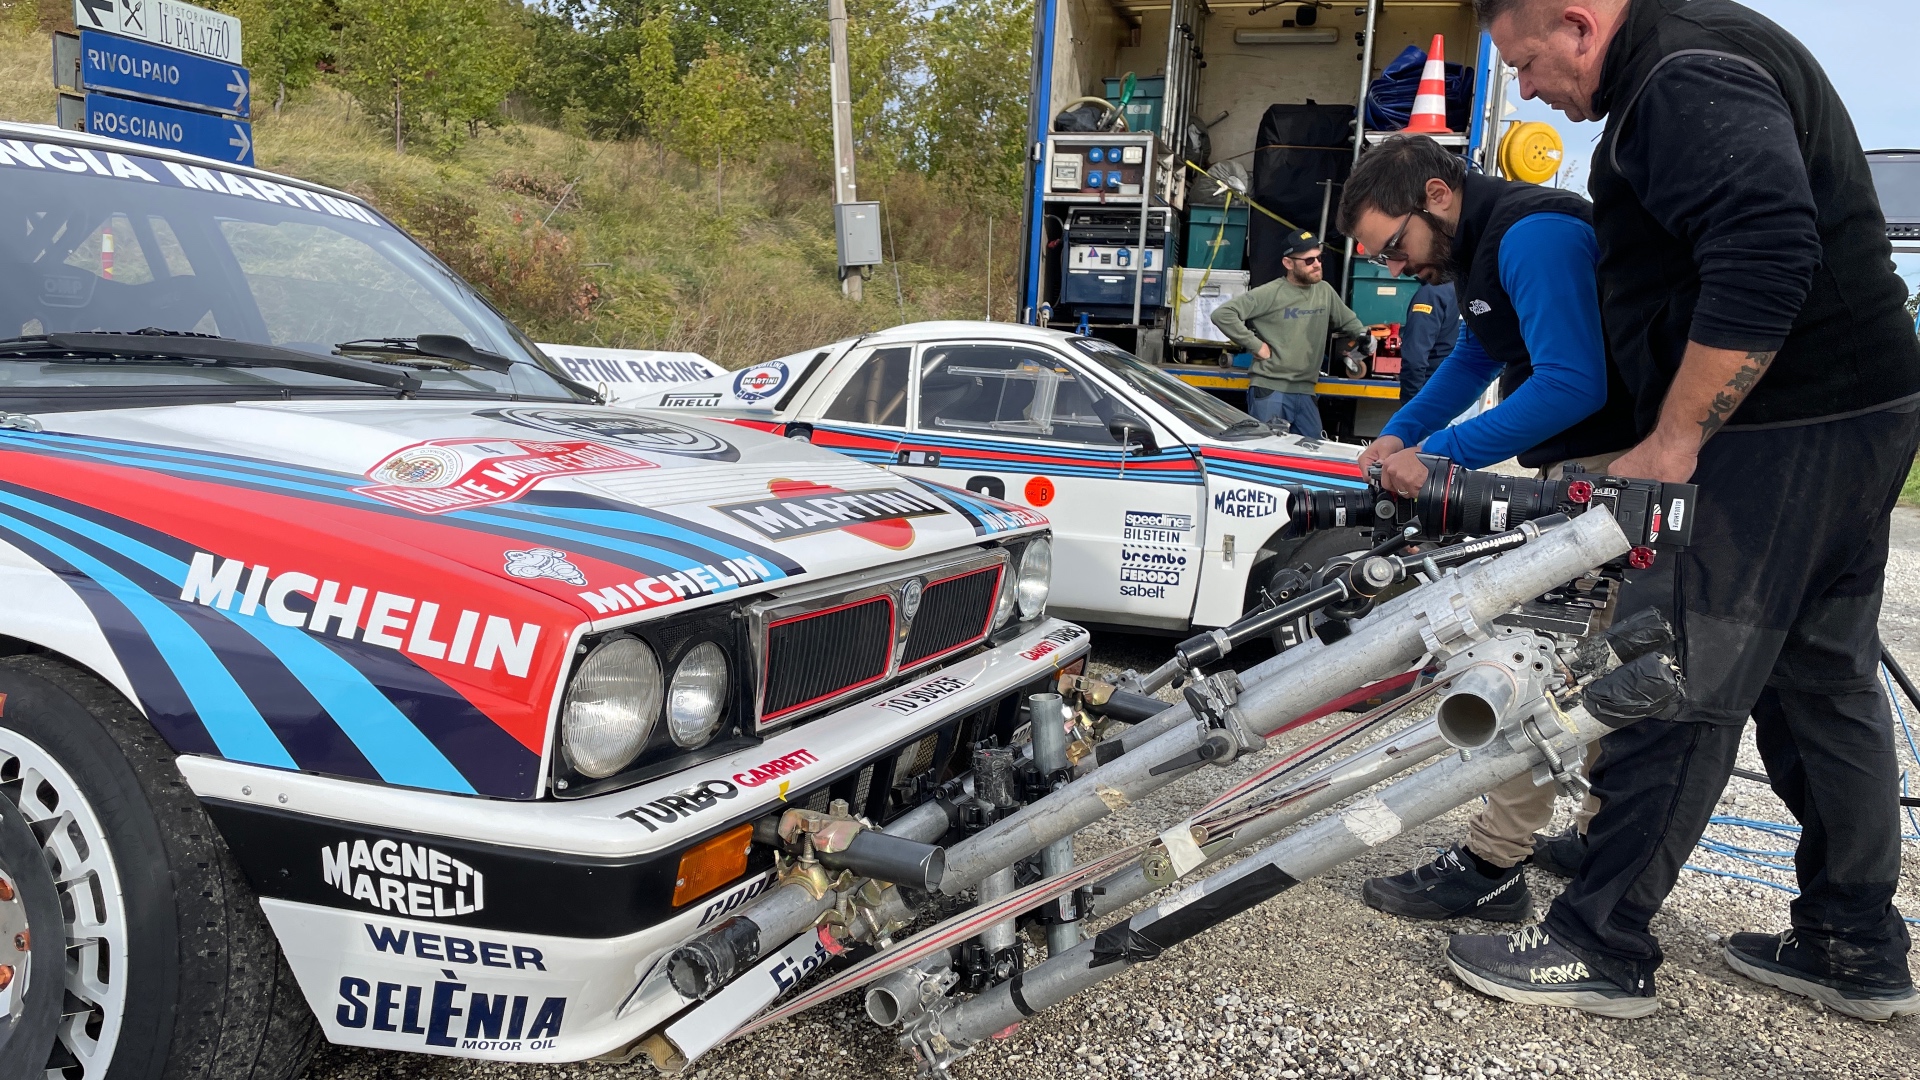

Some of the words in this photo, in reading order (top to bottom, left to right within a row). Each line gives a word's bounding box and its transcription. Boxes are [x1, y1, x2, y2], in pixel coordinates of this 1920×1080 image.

[164, 3, 221, 28] RISTORANTE
[158, 2, 172, 44] IL
[175, 17, 230, 59] PALAZZO
[88, 49, 180, 85] RIVOLPAIO
[93, 111, 183, 142] ROSCIANO
[160, 161, 381, 227] MARTINI
[626, 360, 716, 384] RACING
[744, 377, 778, 385] MARTINI
[659, 393, 723, 407] PIRELLI
[1215, 488, 1277, 506] MAGNETI
[732, 492, 934, 534] MARTINI
[979, 509, 1047, 531] MICHELIN
[1126, 513, 1184, 528] speedline
[1215, 501, 1277, 518] MARELLI
[1124, 528, 1180, 543] BILSTEIN
[1464, 532, 1524, 553] Manfrotto
[1122, 549, 1186, 565] brembo
[578, 555, 771, 614] MICHELIN
[1121, 569, 1178, 585] FERODO
[1120, 585, 1165, 598] sabelt
[180, 551, 542, 678] MICHELIN
[616, 779, 739, 833] TURBO
[732, 748, 820, 788] GARRETT
[321, 839, 484, 890] MAGNETI
[322, 866, 484, 917] MARELLI
[1476, 874, 1521, 907] DYNAFIT
[364, 923, 548, 972] WEBER
[1530, 962, 1591, 985] HOKA
[335, 969, 567, 1048] SELÈNIA
[461, 1039, 522, 1052] MOTOR
[529, 1038, 557, 1051] OIL
